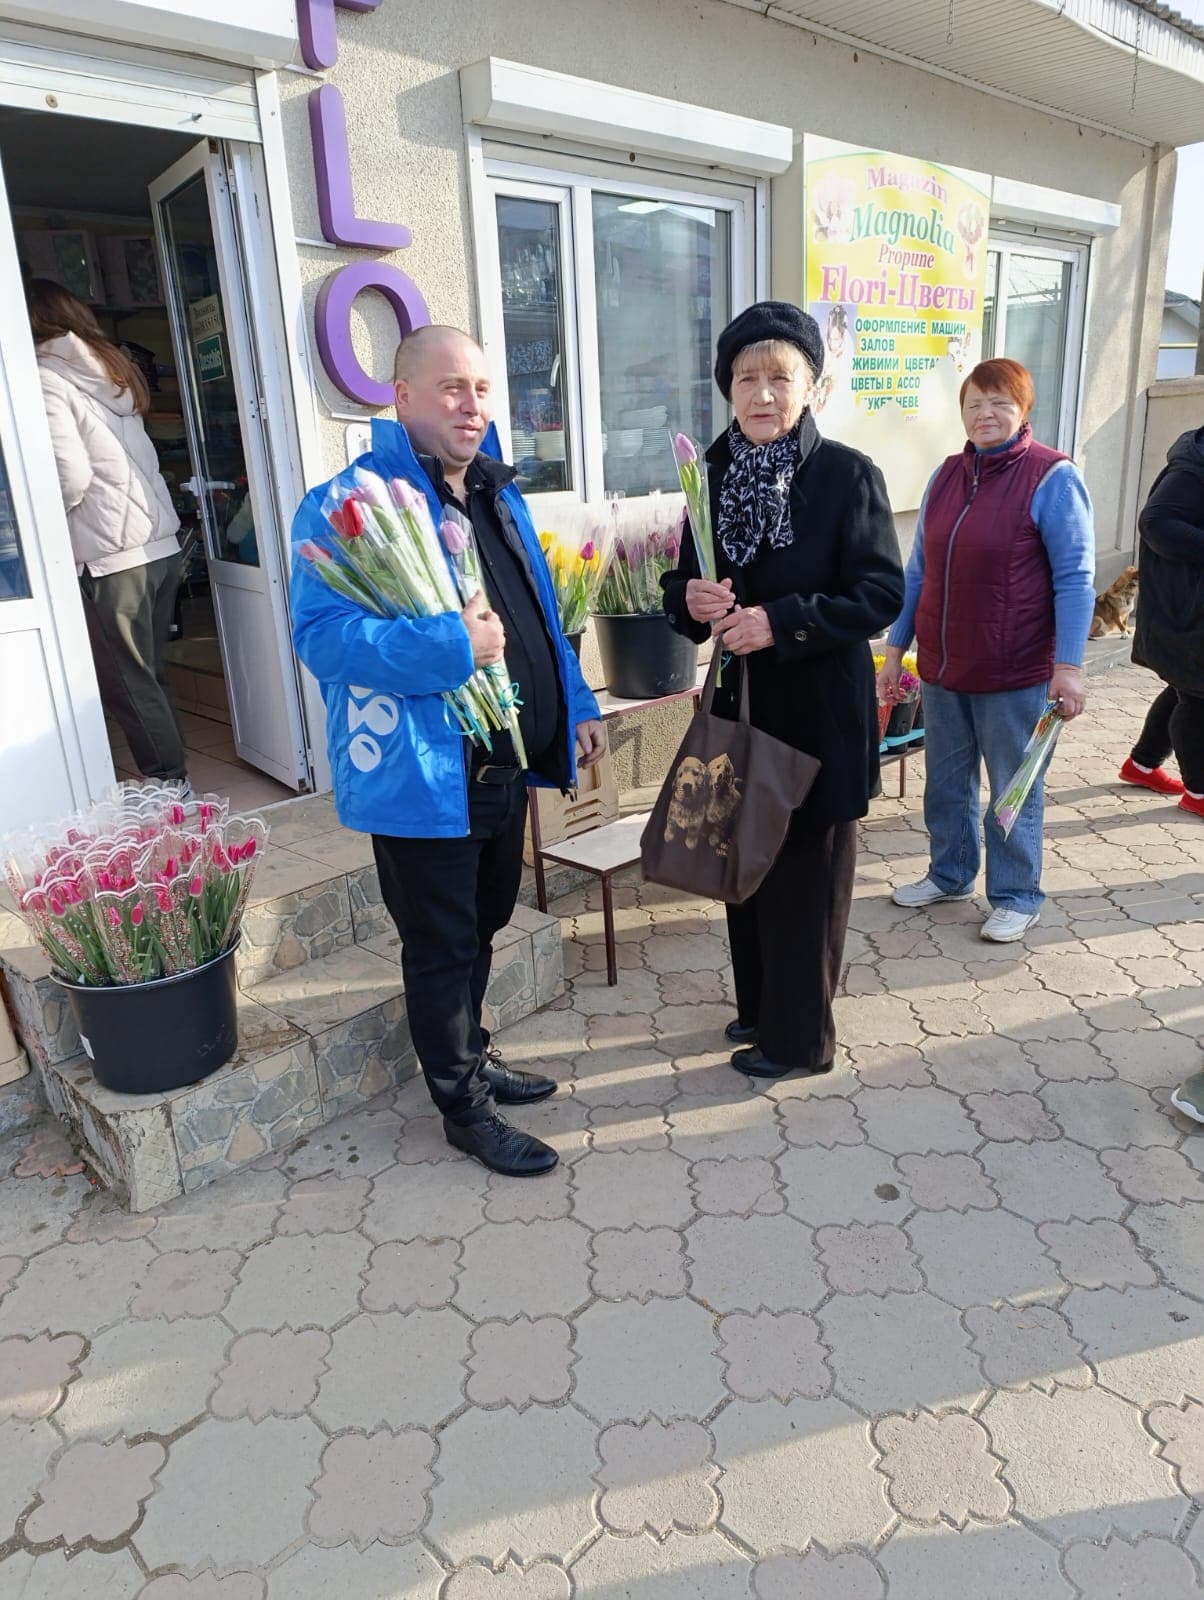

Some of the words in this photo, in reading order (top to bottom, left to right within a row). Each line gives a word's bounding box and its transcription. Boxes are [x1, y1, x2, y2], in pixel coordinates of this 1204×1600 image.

[867, 166, 948, 204] Magazin
[848, 202, 955, 255] Magnolia
[878, 243, 935, 270] Propune
[819, 264, 976, 312] Flori-Цветы
[855, 318, 926, 335] ОФОРМЛЕНИЕ
[860, 337, 895, 352] ЗАЛОВ
[905, 357, 939, 372] ЦВЕТА
[851, 376, 884, 392] ЦВЕТЫ
[886, 377, 893, 390] В
